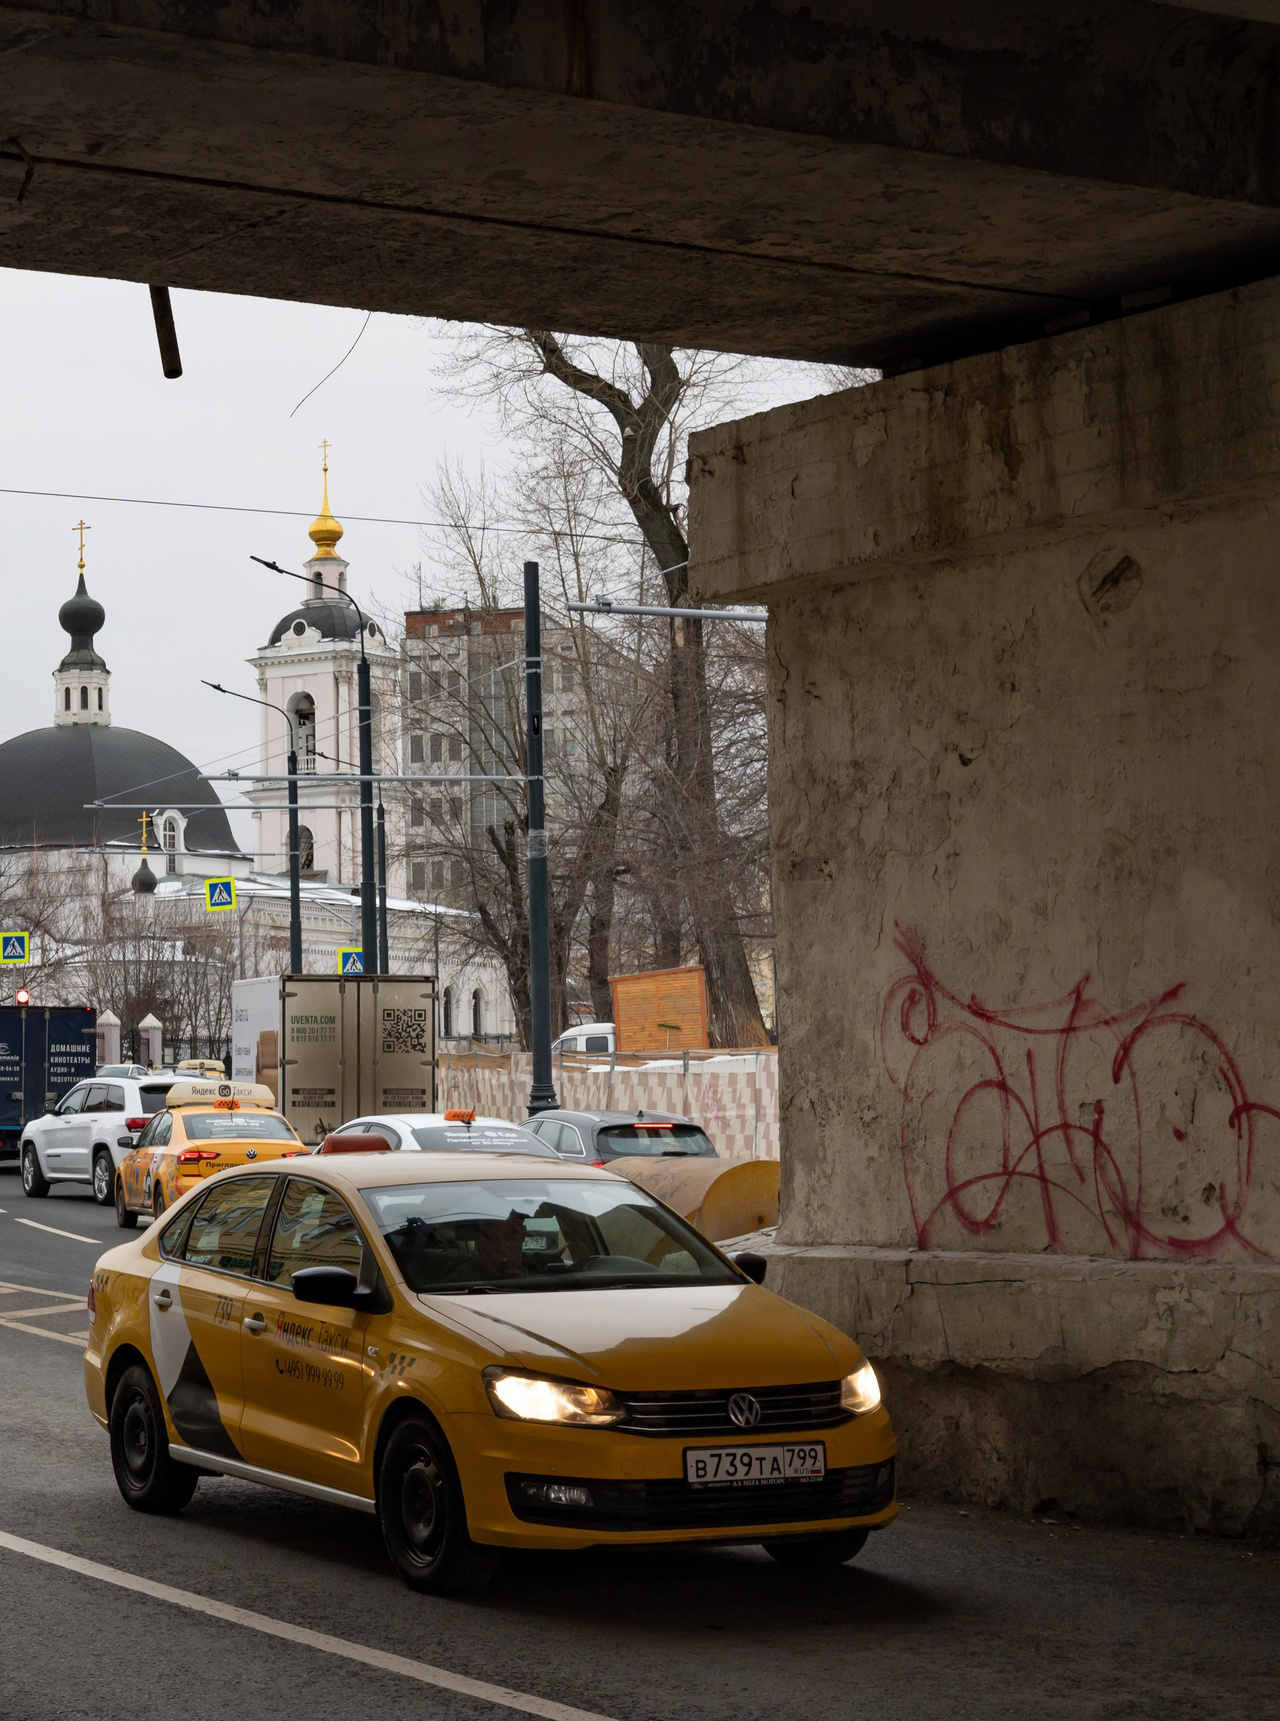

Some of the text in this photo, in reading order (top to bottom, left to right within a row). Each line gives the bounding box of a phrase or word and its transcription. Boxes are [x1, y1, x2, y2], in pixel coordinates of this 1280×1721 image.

[290, 1015, 336, 1025] UVENTA.COM
[50, 1044, 90, 1053] ДОМАШНИЕ
[50, 1056, 90, 1064] КИНОТЕАТРЫ
[191, 1086, 252, 1096] Яндекс Go Такси
[213, 1295, 234, 1326] 739
[274, 1311, 349, 1357] Яндекс Такси
[284, 1359, 345, 1391] (495) 999 99 99
[695, 1447, 819, 1479] В739ТА 799
[794, 1467, 810, 1475] RUS
